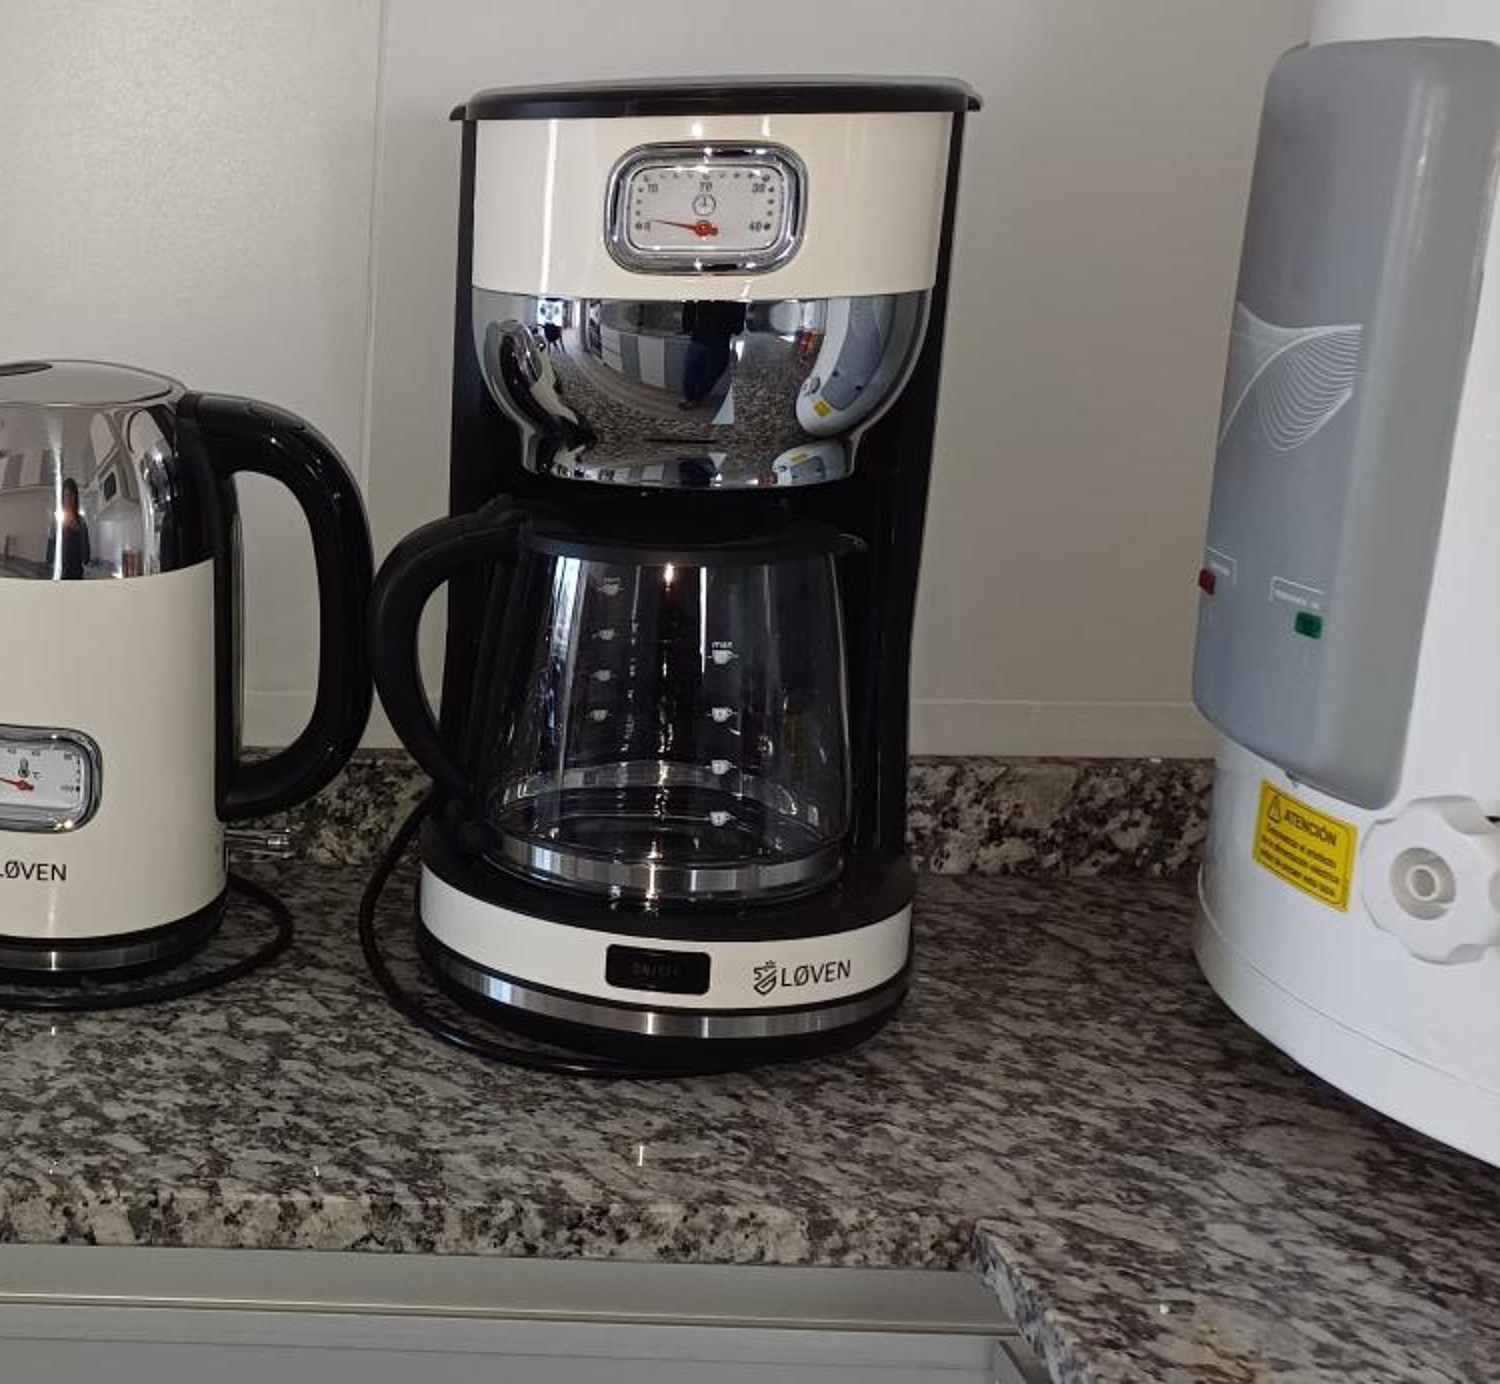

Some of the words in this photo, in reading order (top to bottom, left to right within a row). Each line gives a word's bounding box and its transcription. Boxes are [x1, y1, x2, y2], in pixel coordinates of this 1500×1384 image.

[749, 221, 763, 232] 40
[1284, 809, 1337, 846] ATENCIÓN
[781, 959, 851, 987] LØVEN
